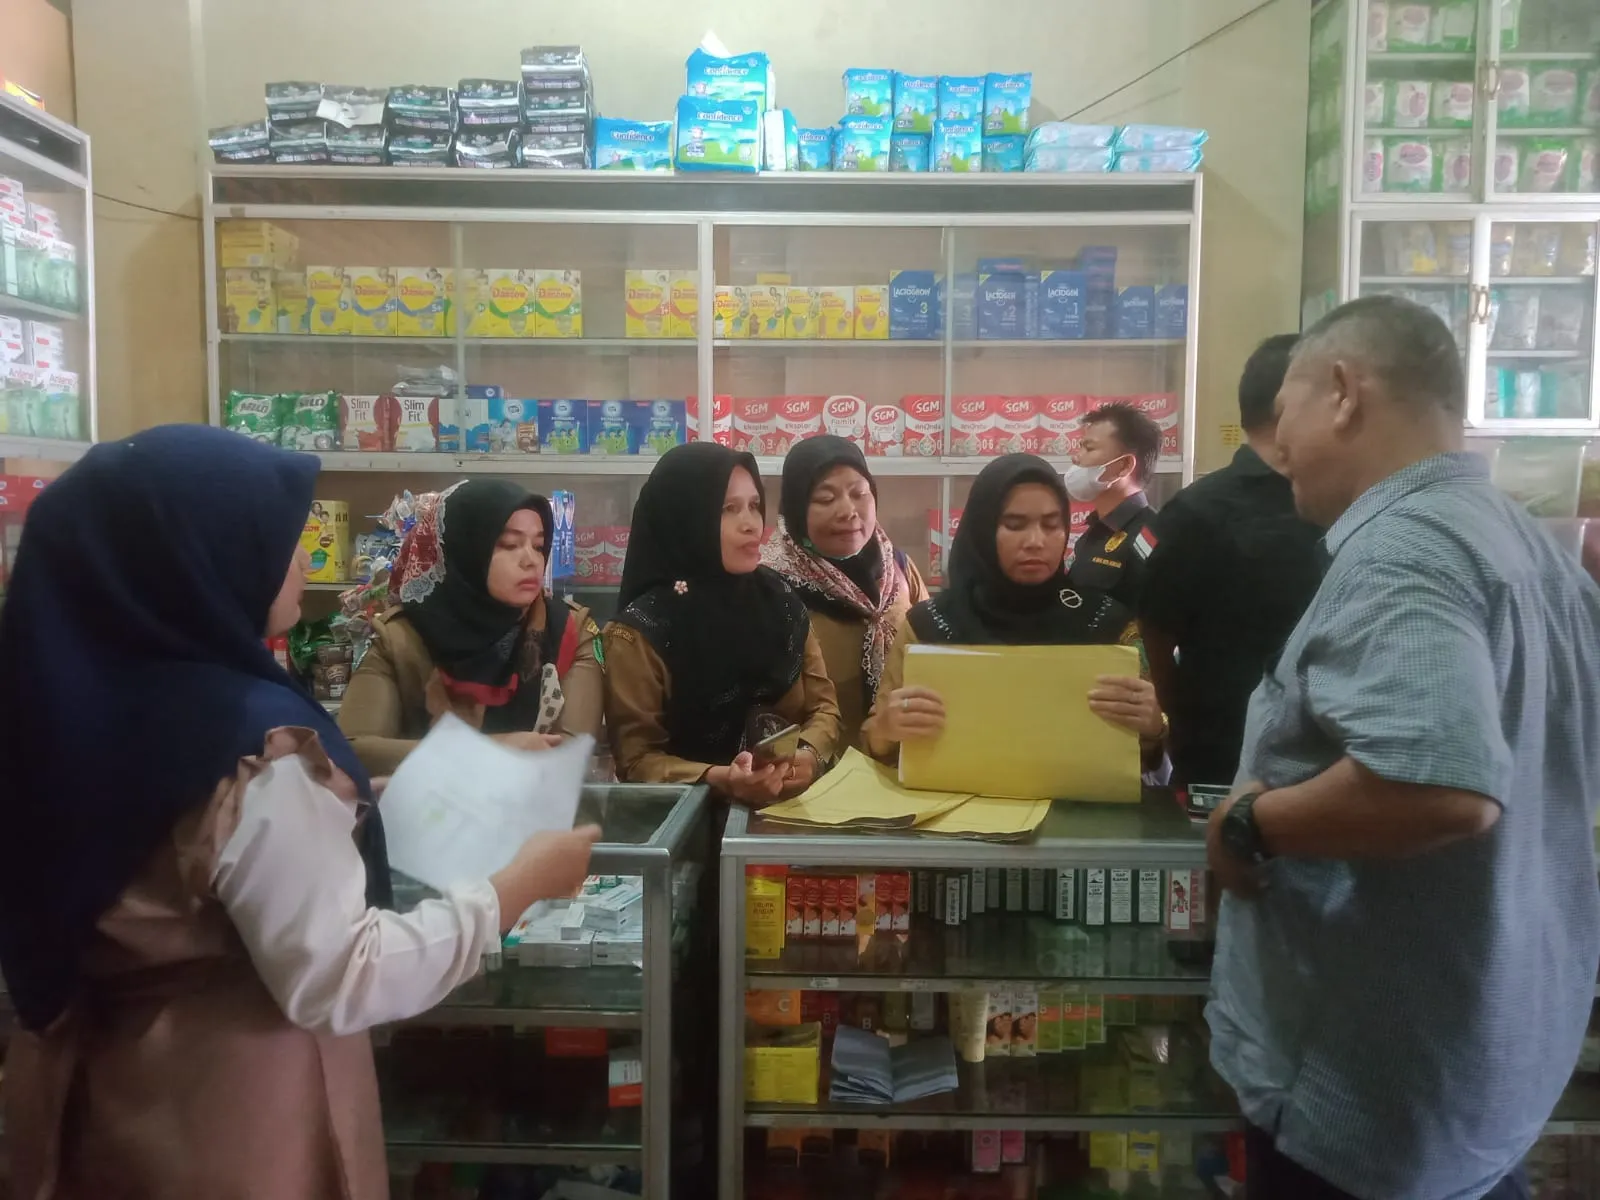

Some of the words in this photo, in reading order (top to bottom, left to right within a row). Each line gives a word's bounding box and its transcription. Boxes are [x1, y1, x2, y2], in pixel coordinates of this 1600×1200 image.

[704, 65, 749, 76] Confidence
[697, 111, 744, 122] Confidence
[611, 129, 655, 142] Confidence
[985, 290, 1016, 301] LACTOGEN
[1048, 288, 1079, 298] LACTOGEN
[920, 301, 928, 314] 3
[1008, 305, 1017, 315] 2
[351, 398, 370, 410] Slim
[404, 399, 425, 411] Slim
[745, 403, 768, 416] SGM
[785, 401, 810, 413] SGM
[831, 401, 855, 414] SGM
[916, 400, 940, 413] SGM
[961, 401, 985, 413] SGM
[1006, 400, 1030, 413] SGM
[1051, 400, 1075, 413] SGM
[1142, 398, 1167, 412] SGM
[355, 409, 367, 421] Fit
[408, 410, 421, 422] Fit
[874, 410, 895, 422] SGM
[1070, 510, 1090, 524] GM
[575, 531, 595, 543] SGM
